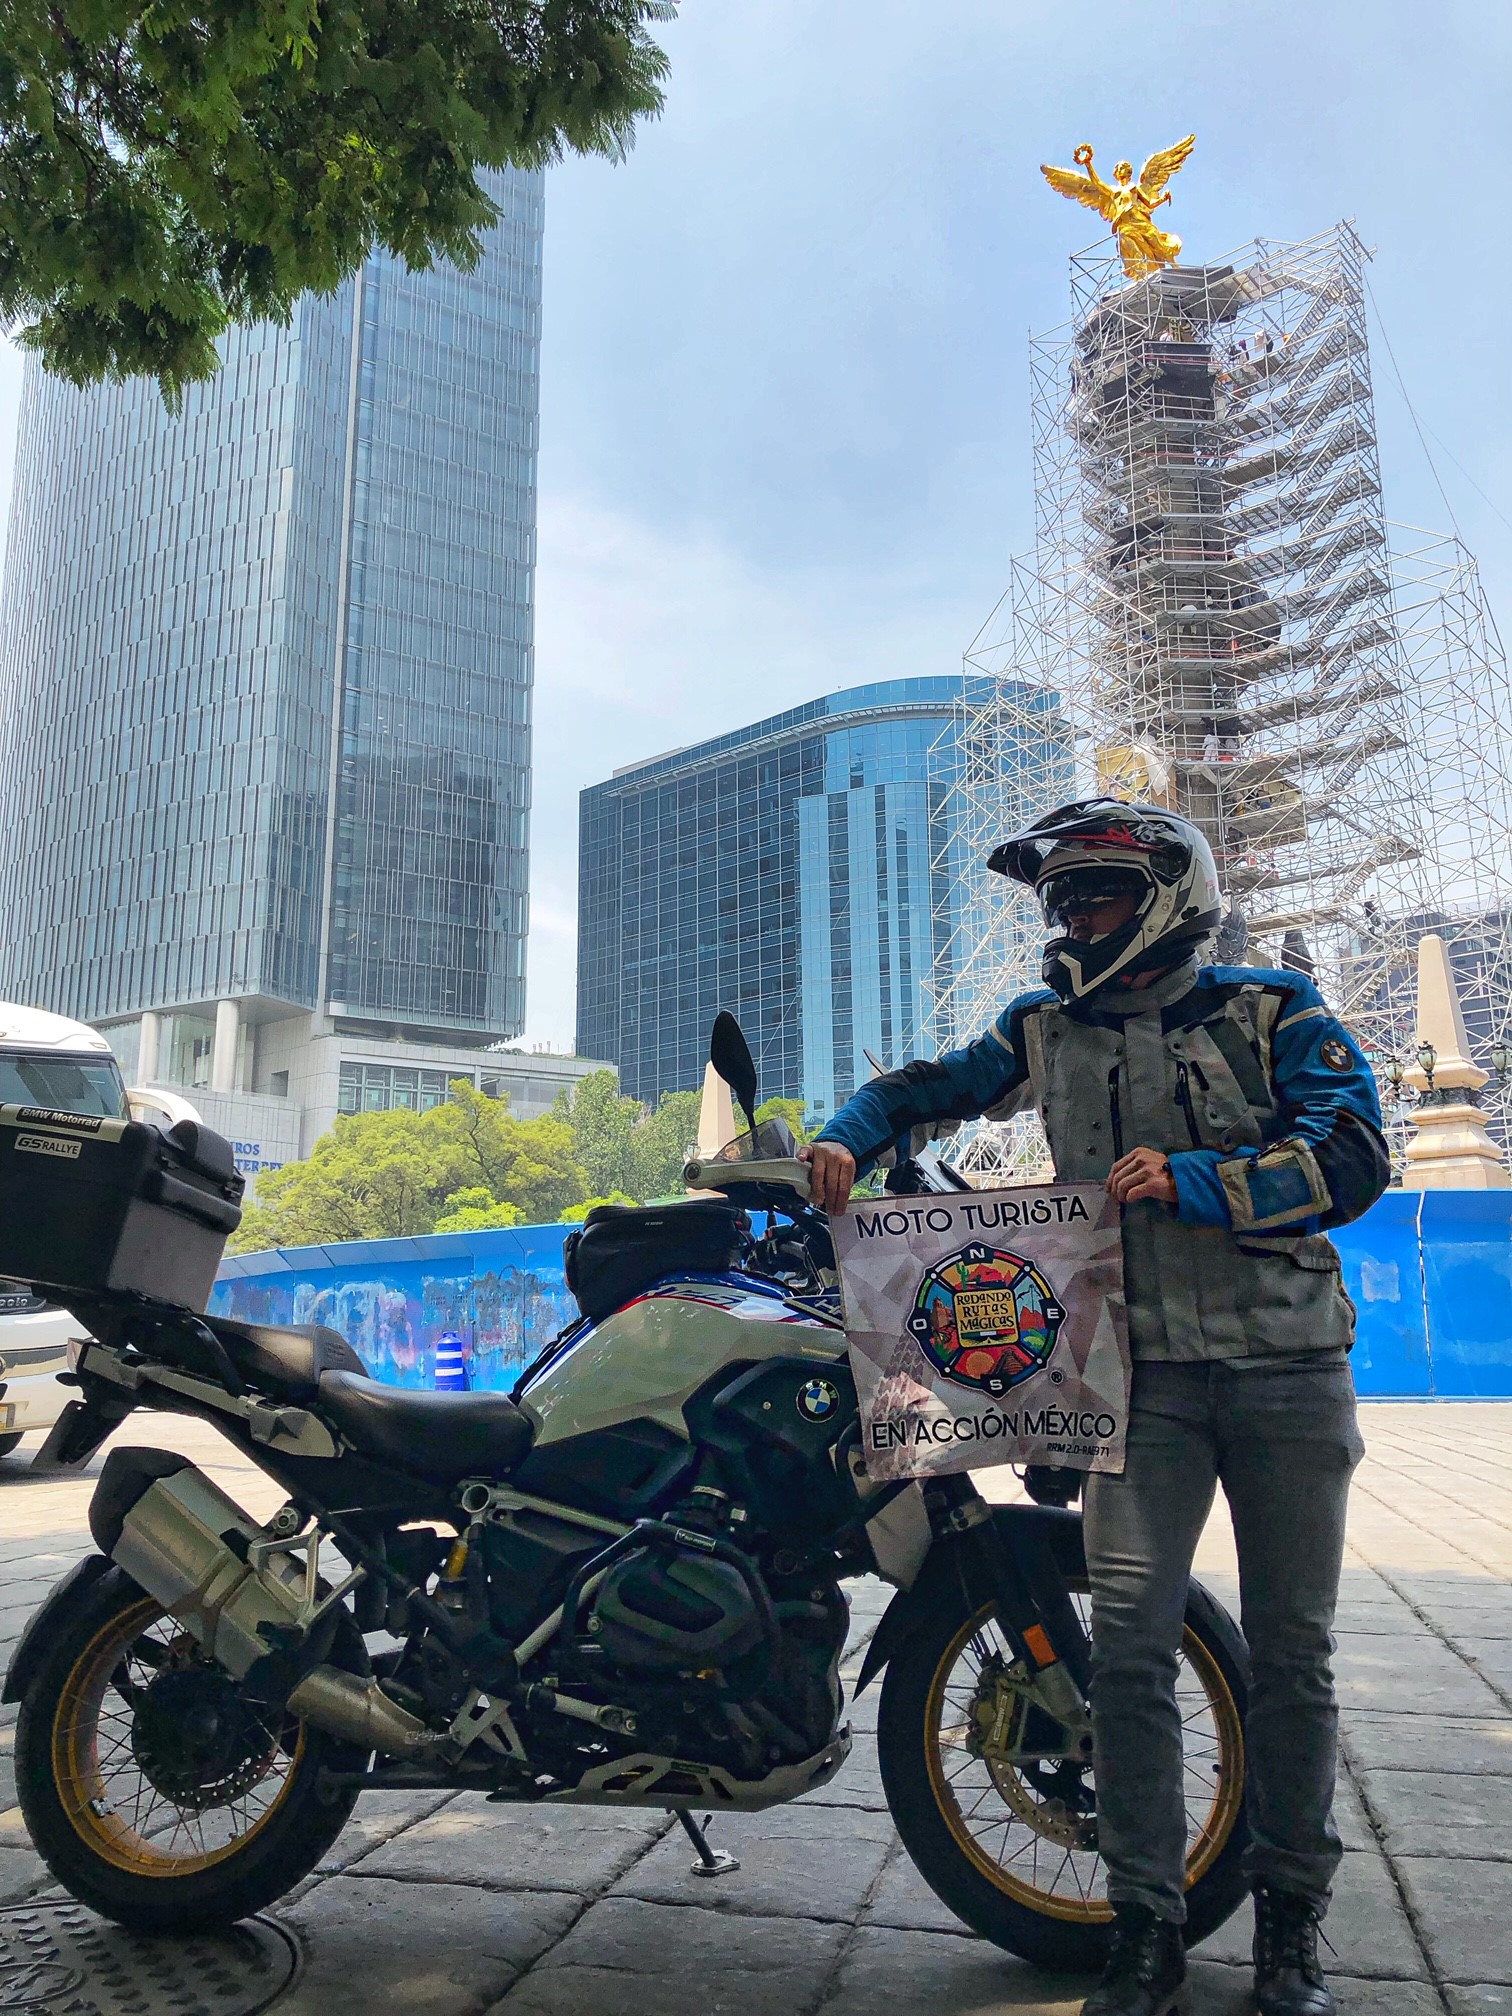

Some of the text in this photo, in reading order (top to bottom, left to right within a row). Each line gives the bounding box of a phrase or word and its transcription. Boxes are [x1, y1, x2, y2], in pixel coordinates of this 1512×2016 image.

[22, 1108, 100, 1127] BMW Motorrad
[42, 1141, 79, 1155] RALLYE
[230, 1142, 260, 1155] ROS
[856, 1196, 1089, 1238] MOTO TURISTA
[970, 1248, 985, 1258] N
[1047, 1308, 1060, 1319] E
[990, 1379, 1003, 1390] S
[872, 1404, 1116, 1450] EN ACCIÓN MÉXICO
